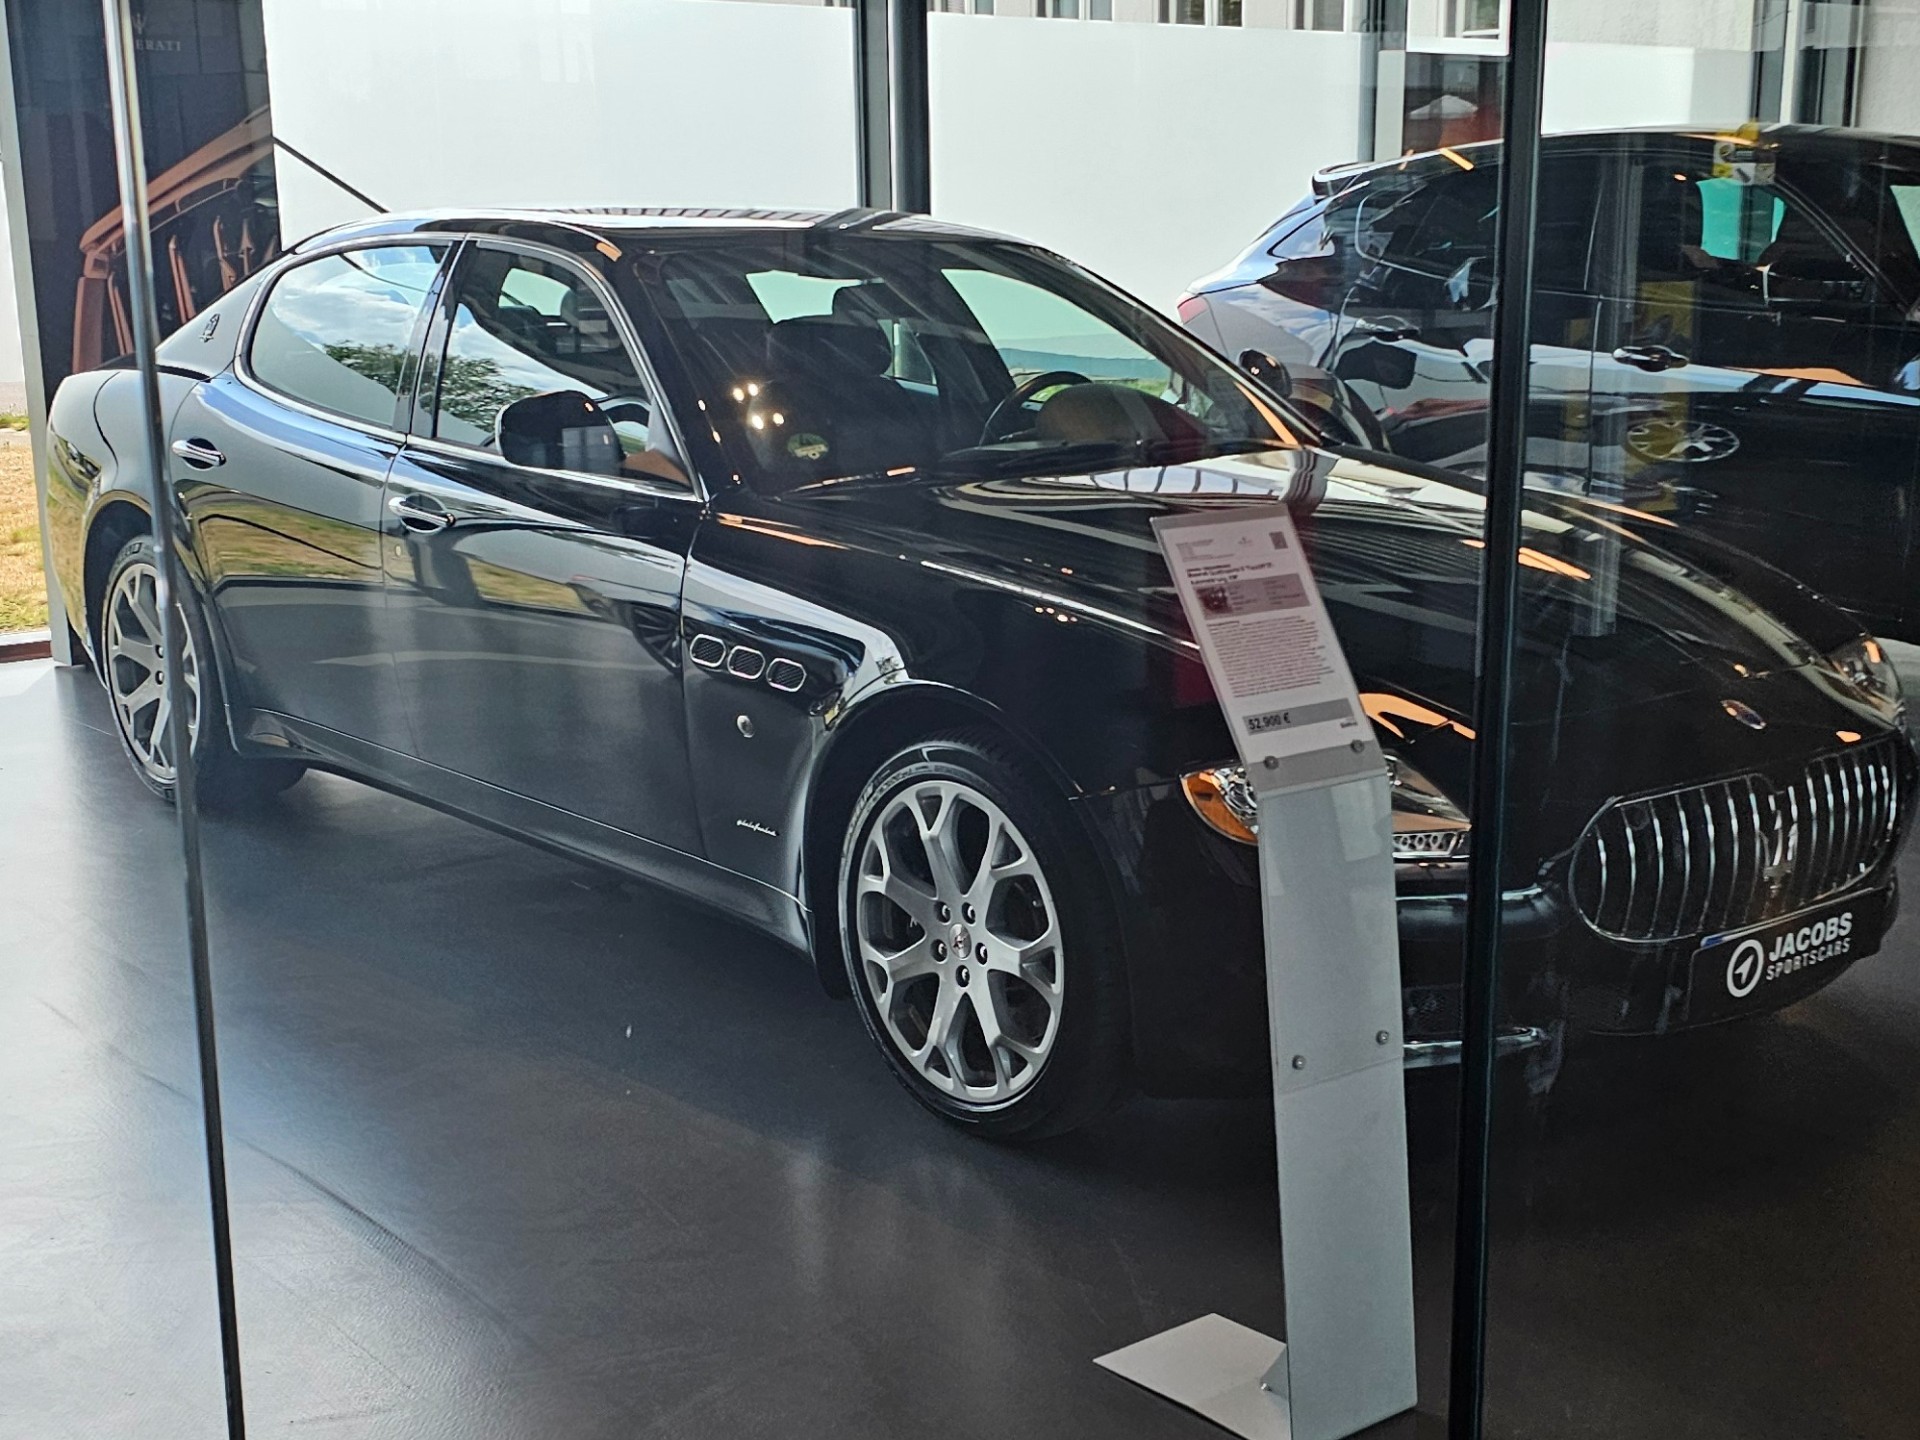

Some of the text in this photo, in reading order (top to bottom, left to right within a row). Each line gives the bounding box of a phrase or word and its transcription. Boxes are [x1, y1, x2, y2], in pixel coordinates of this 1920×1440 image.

[1283, 712, 1291, 724] €
[1768, 911, 1853, 962] JACOBS
[1765, 937, 1851, 981] SPORTSCARS
